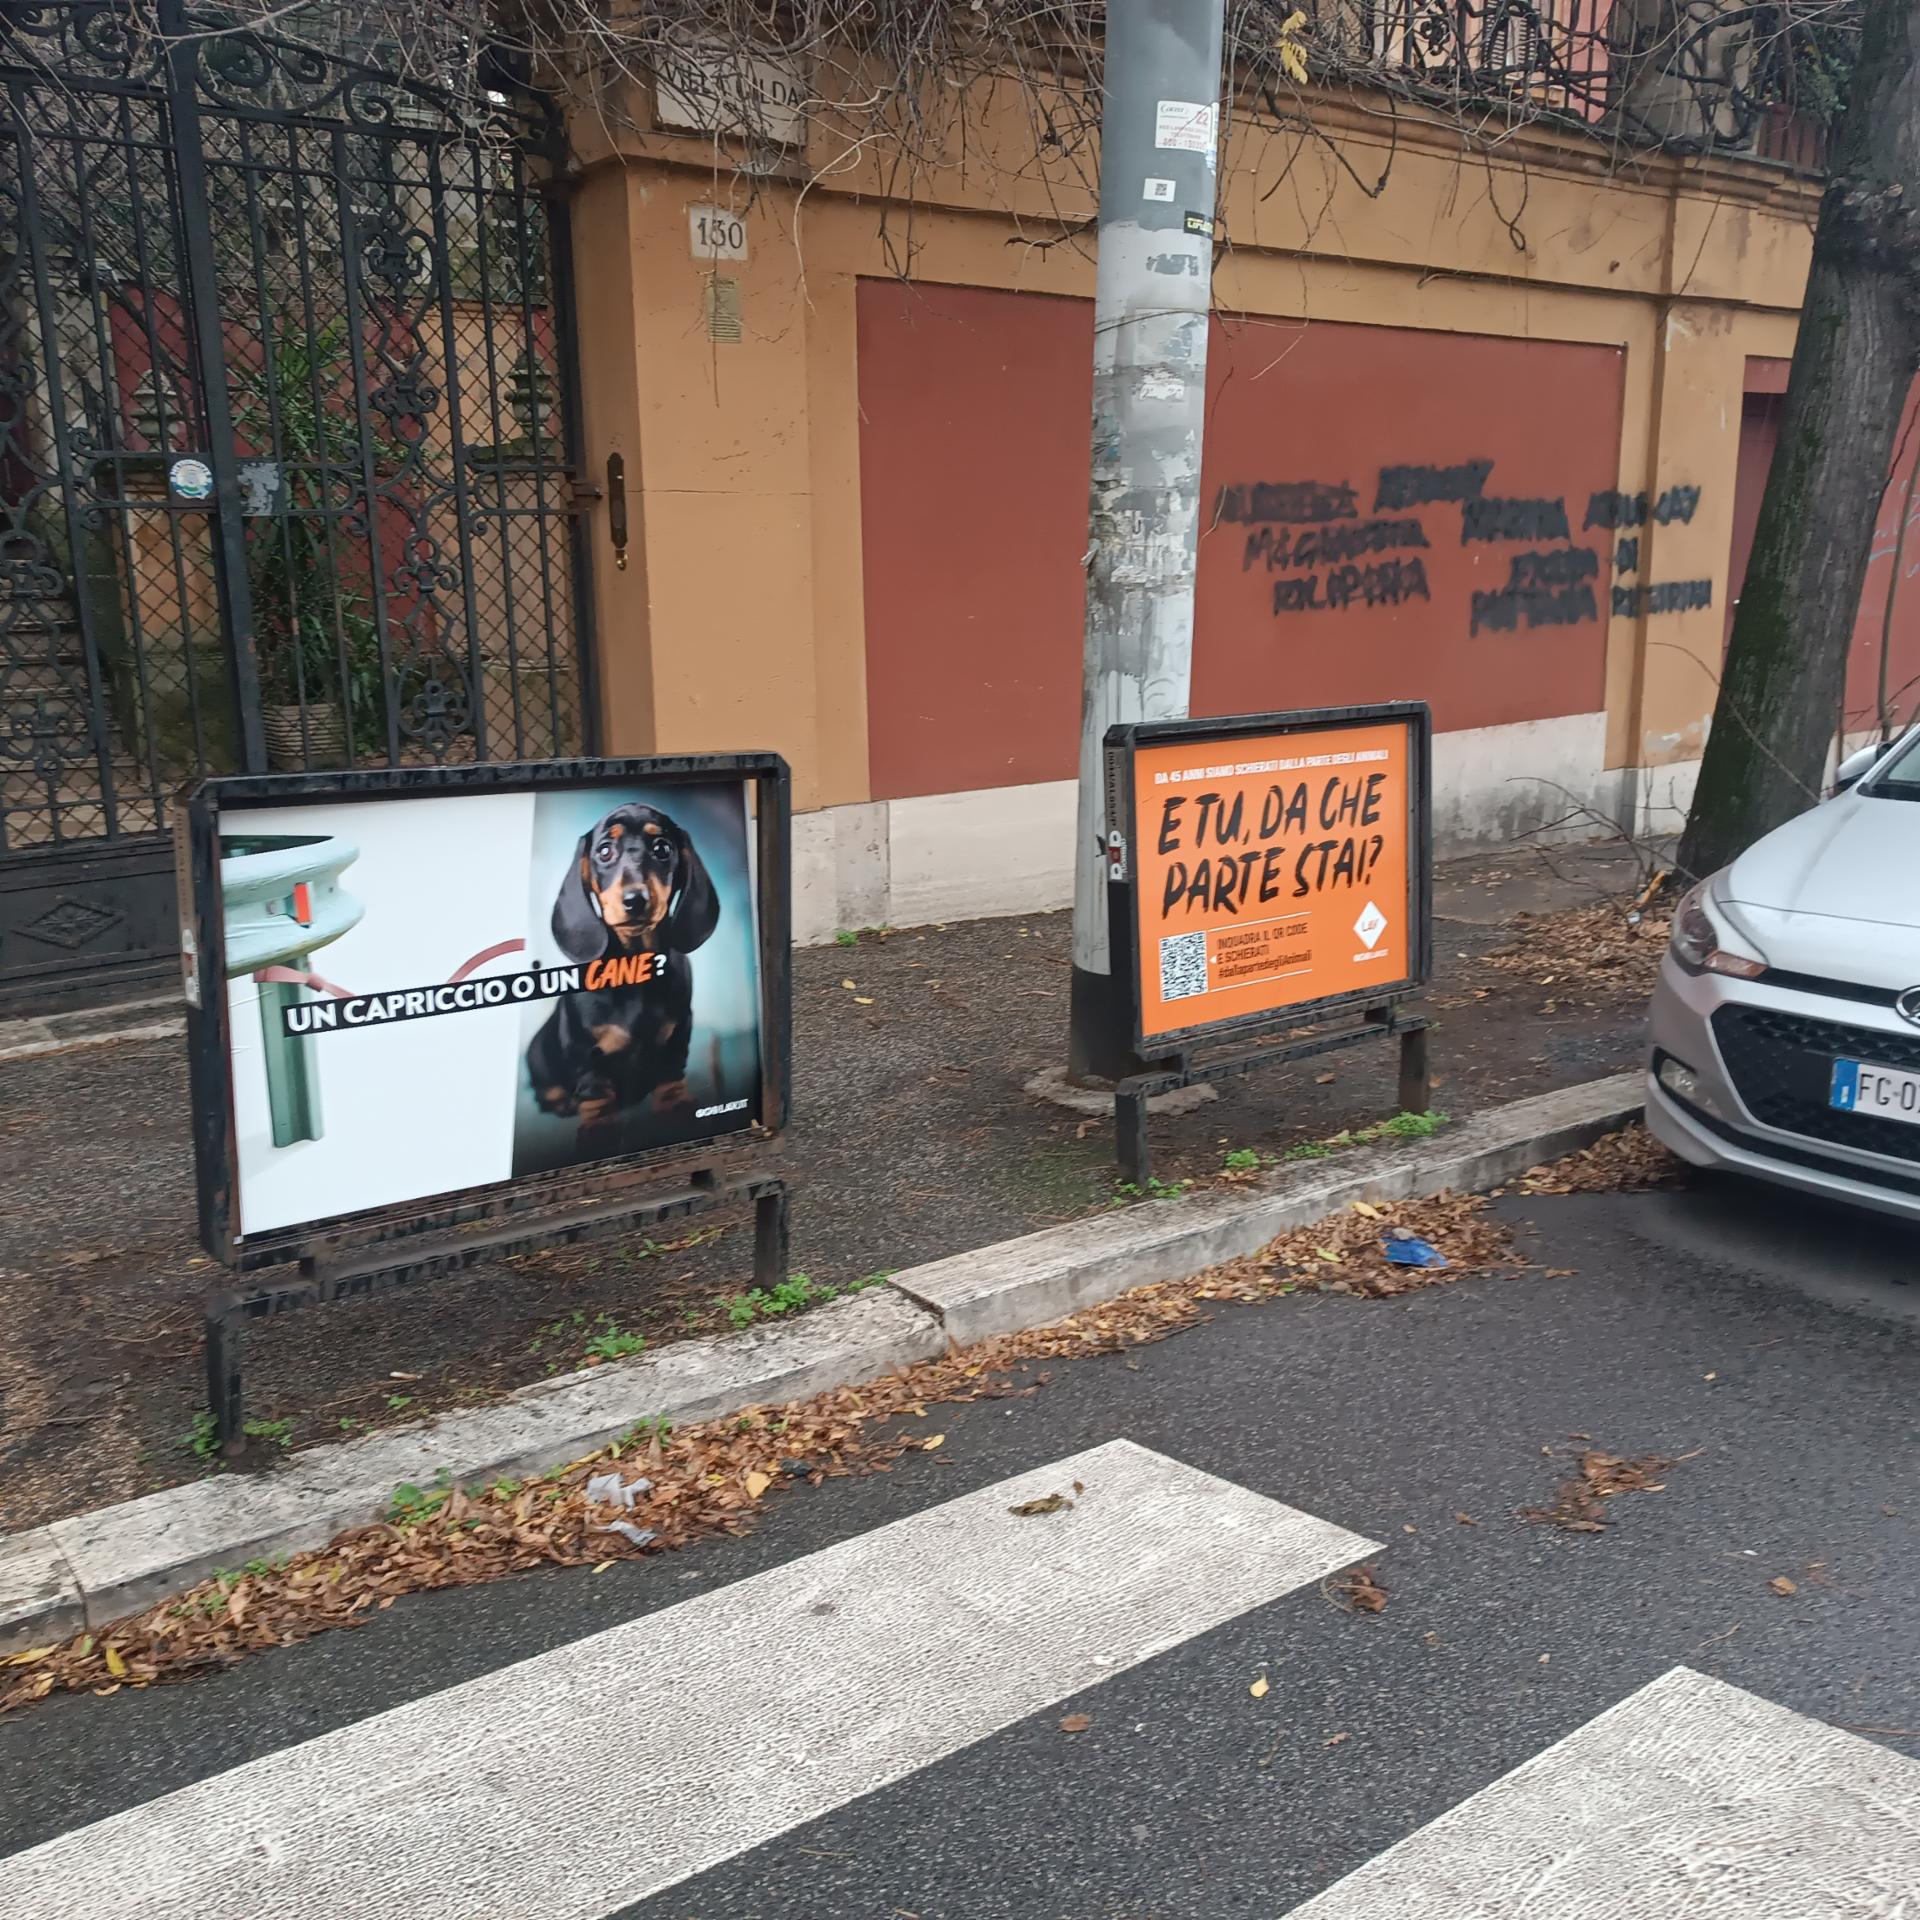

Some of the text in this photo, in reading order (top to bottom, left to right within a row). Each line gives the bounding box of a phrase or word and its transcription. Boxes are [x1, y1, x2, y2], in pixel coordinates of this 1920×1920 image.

[697, 217, 743, 249] 130
[1158, 773, 1387, 855] E TU, DA CHE
[1162, 846, 1286, 920] PARTE
[1292, 835, 1384, 897] STAI?
[286, 952, 667, 1032] UN CAPRICCIO O UN CANE?
